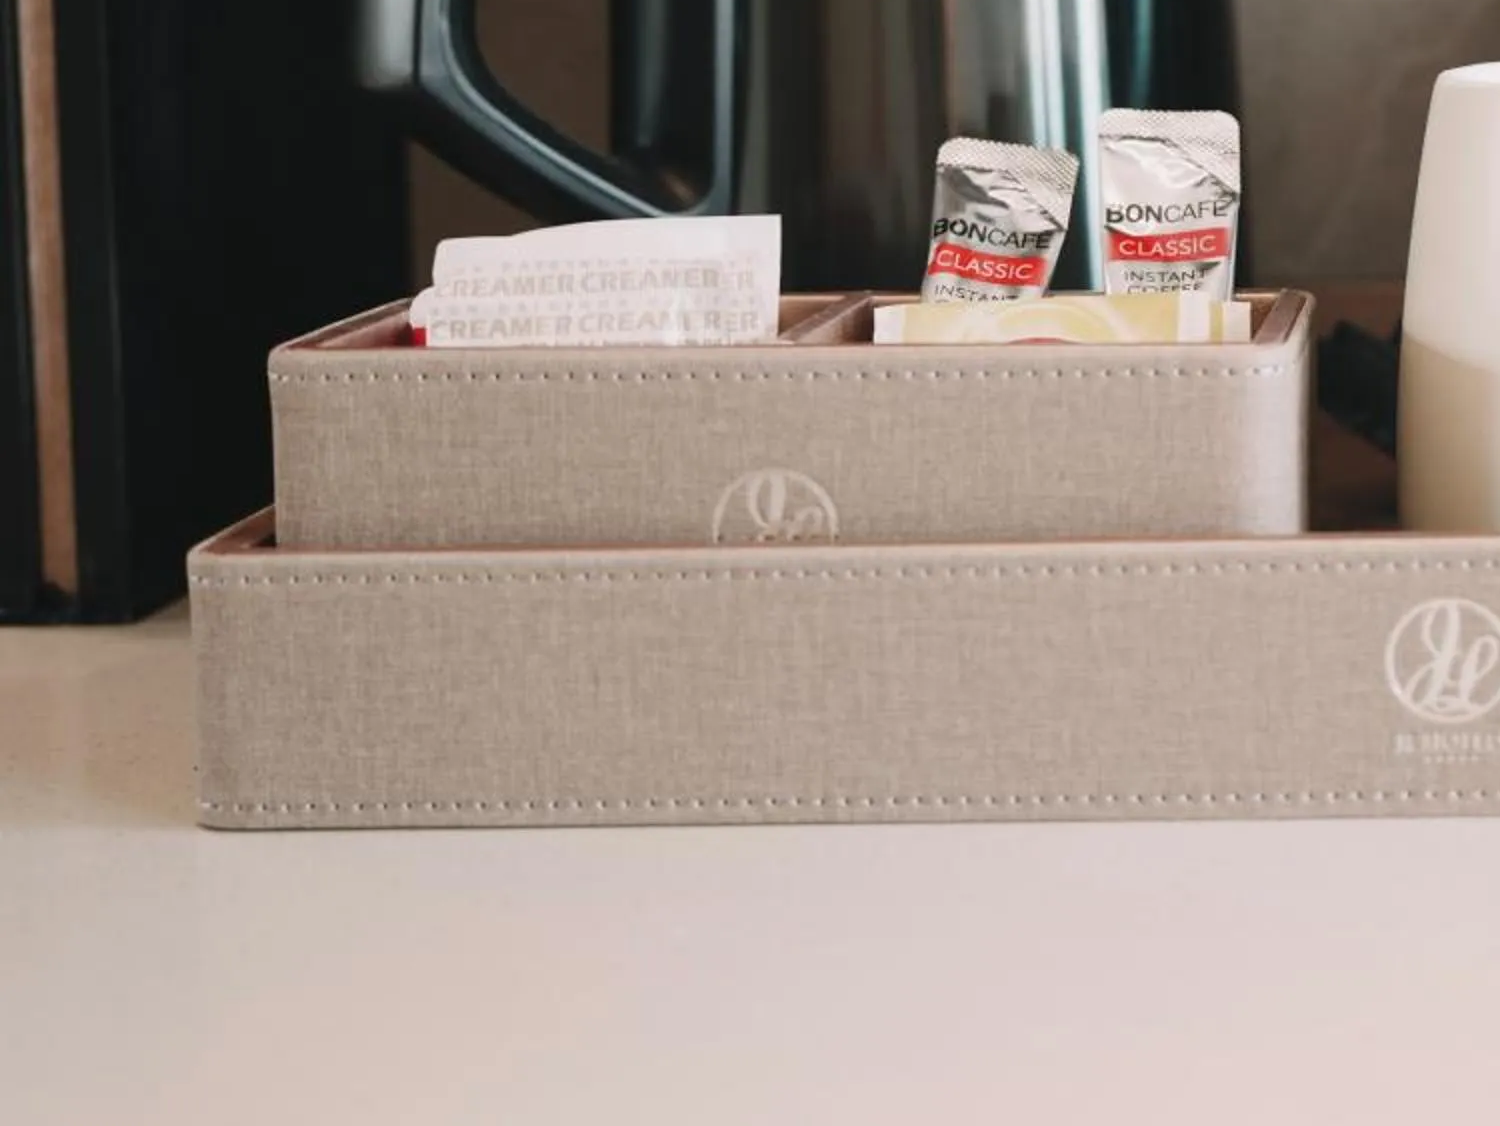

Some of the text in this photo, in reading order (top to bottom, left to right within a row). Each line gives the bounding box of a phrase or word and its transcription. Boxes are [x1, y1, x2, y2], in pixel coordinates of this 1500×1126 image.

[1118, 234, 1218, 257] CLASSIC
[935, 249, 1035, 280] CLASSIC
[1124, 268, 1207, 283] INSTANT
